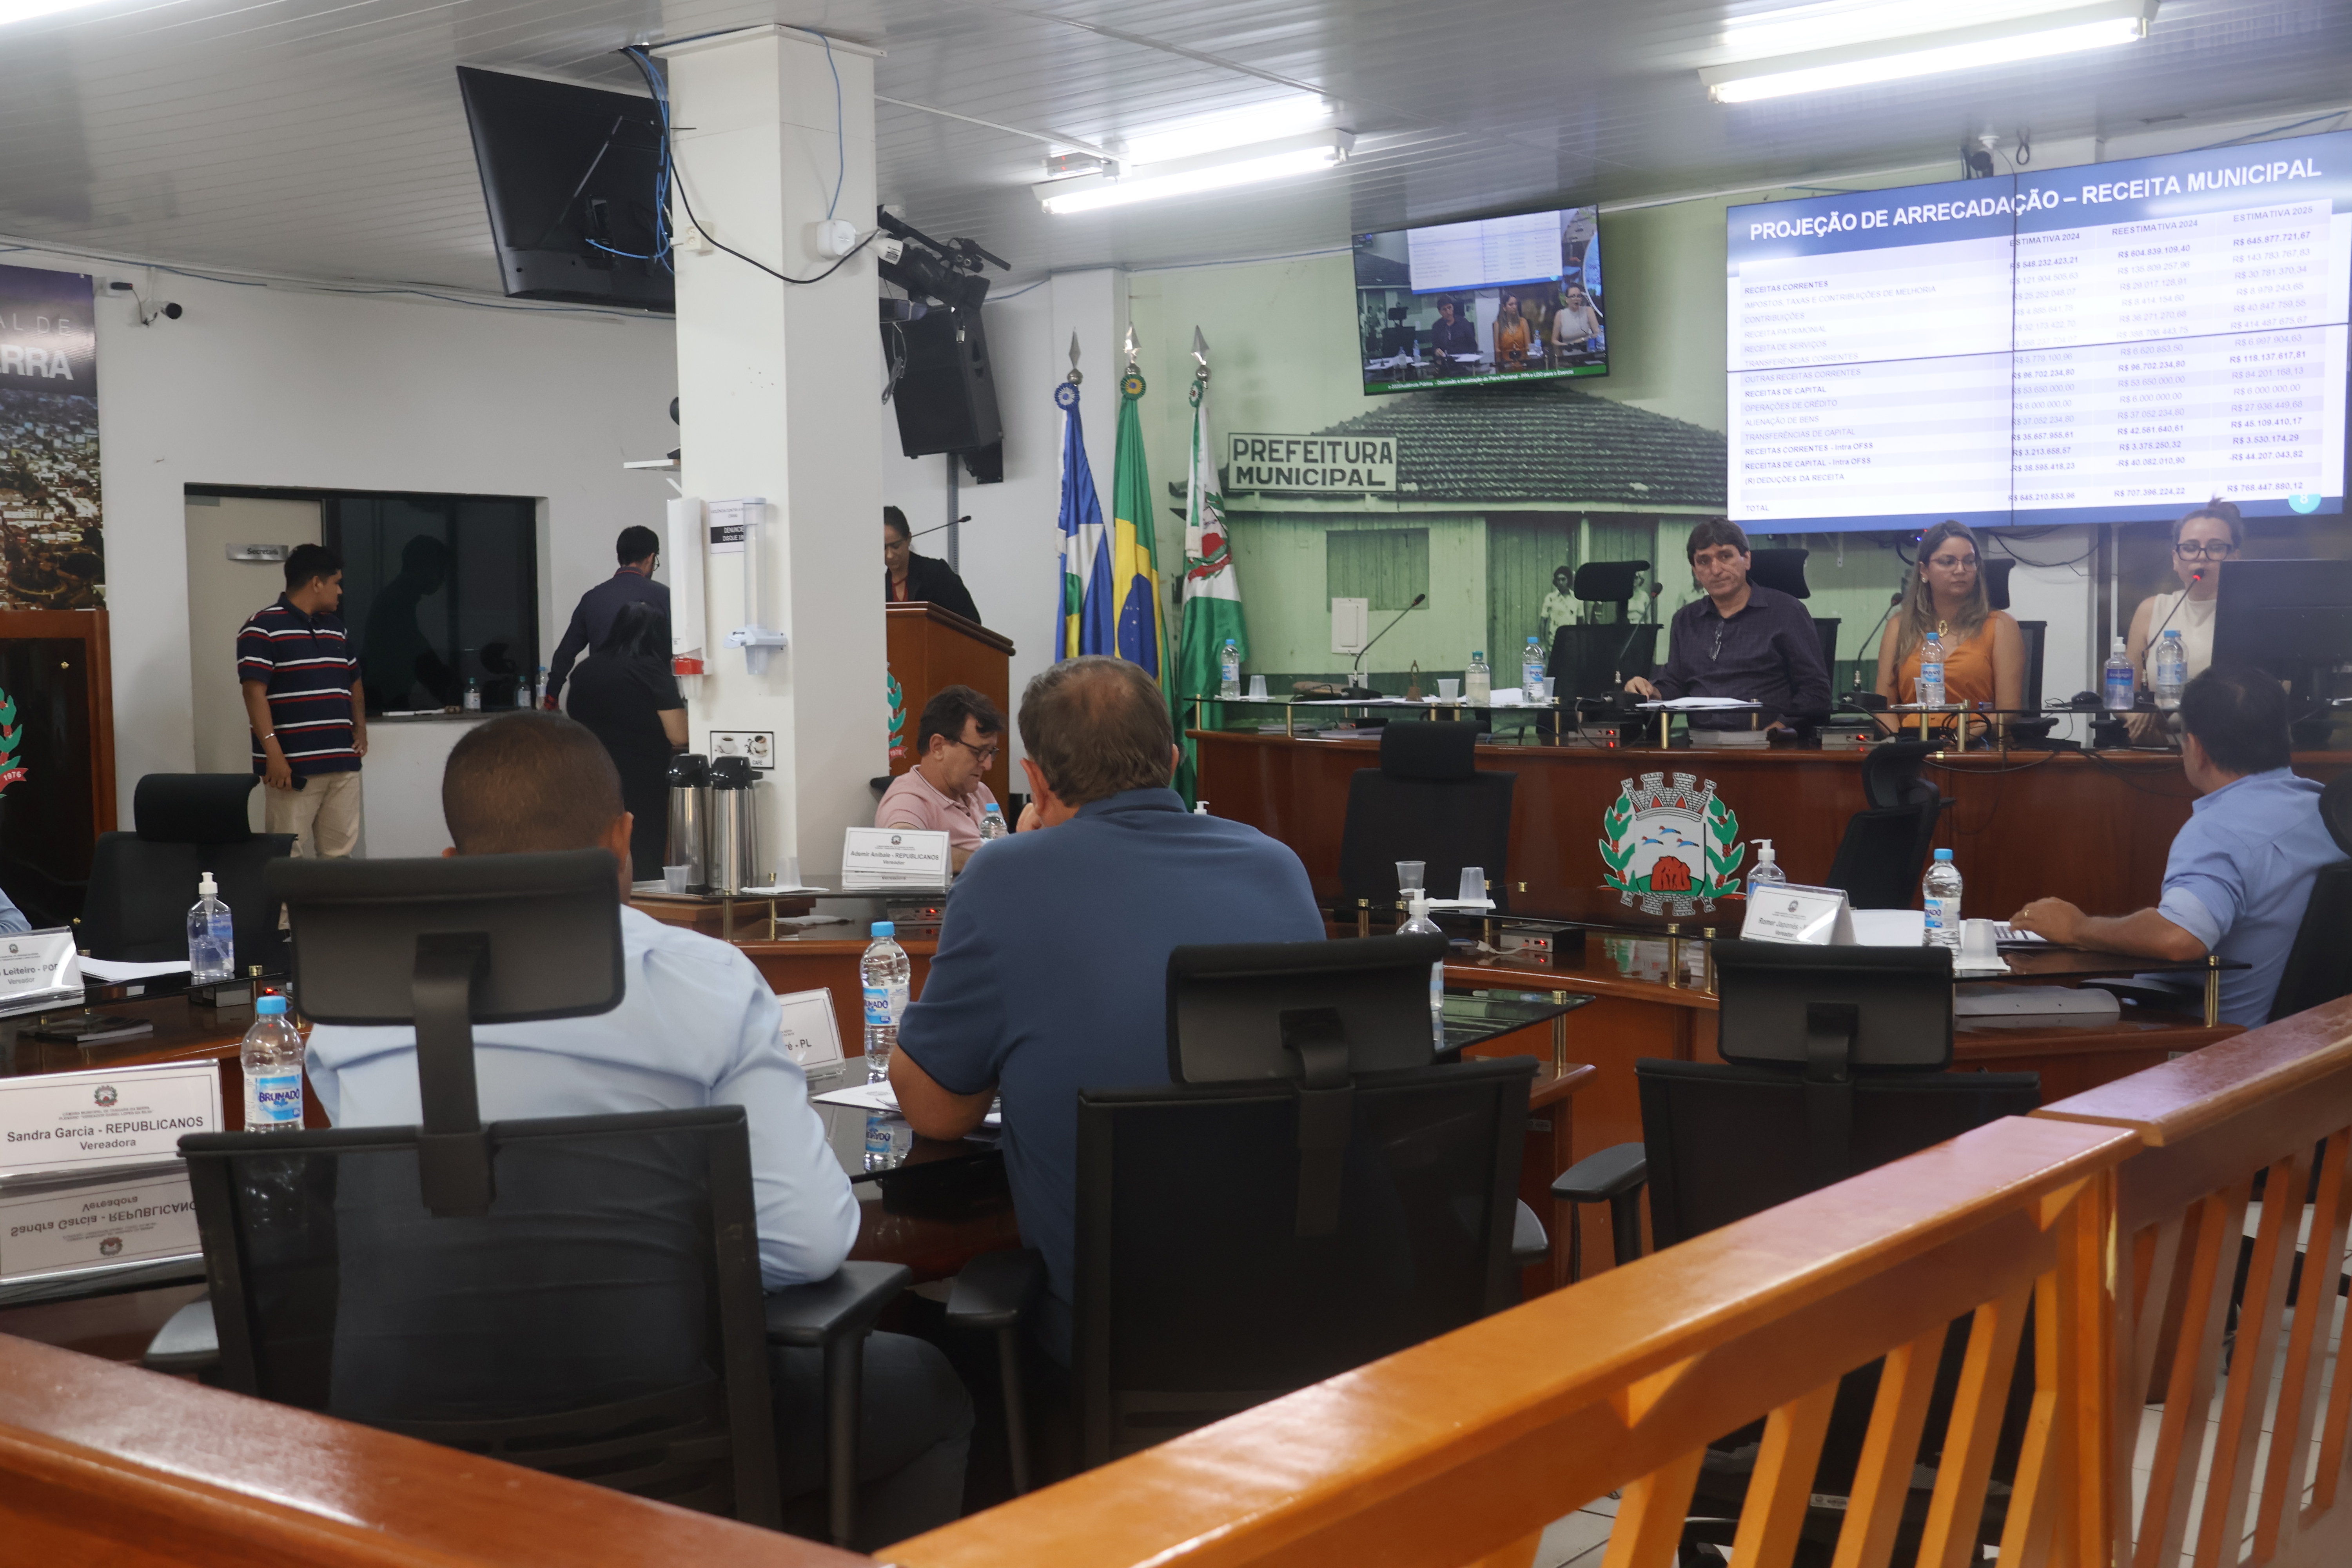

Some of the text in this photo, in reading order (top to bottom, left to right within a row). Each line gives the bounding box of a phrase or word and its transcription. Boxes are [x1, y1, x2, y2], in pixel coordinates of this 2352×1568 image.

[1751, 210, 1857, 243] PROJEÇÃO
[1862, 209, 1888, 229] DE
[1893, 189, 2059, 226] ARRECADAÇÃO
[2082, 175, 2180, 204] RECEITA
[2188, 157, 2321, 191] MUNICIPAL
[2234, 206, 2312, 222] ESTIMATIVA 2025
[2112, 220, 2198, 236] REESTIMATIVA 2024
[2010, 232, 2080, 247] ESTIMATIVA 2024
[2247, 231, 2310, 245] 645.877.721,67
[2131, 245, 2190, 257] 604.839.109,40
[1745, 281, 1828, 294] RECEITAS CORRENTES
[1787, 297, 1809, 305] TAXAS
[1819, 290, 1881, 302] CONTRIBUIÇÕES
[1896, 286, 1936, 296] MELHORIA
[1744, 312, 1805, 324] CONTRIBUIÇÕES
[37, 316, 70, 336] DE
[1745, 325, 1826, 338] RECEITA PATRIMONIAL
[1744, 344, 1775, 353] RECEITA
[1789, 340, 1827, 350] SERVIÇOS
[0, 344, 74, 380] RRA
[1745, 353, 1858, 367] TRANSFERÊNCIAS CORRENTES
[2244, 351, 2305, 362] 118.137.617,81
[2131, 360, 2185, 371] 96.702.234,80
[1745, 368, 1861, 383] OUTRAS RECEITAS CORRENTES
[2024, 369, 2074, 378] 96.702.234,80
[1745, 389, 1781, 397] RECEITAS
[1745, 403, 1789, 412] OPERAÇÕES
[1804, 399, 1837, 408] CRÉDITO
[1745, 417, 1785, 426] ALIENAÇÃO
[2245, 417, 2302, 428] 45.109.410,17
[1746, 431, 1810, 441] TRANSFERÊNCIAS
[1825, 428, 1855, 436] CAPITAL
[2130, 425, 2183, 434] 42.561.640,61
[2247, 434, 2299, 443] 3.530.174,29
[1234, 439, 1393, 464] PREFEITURA
[1783, 445, 1828, 453] CORRENTES
[2132, 441, 2181, 450] 3.375.250,32
[2245, 450, 2303, 460] 44.207.043,82
[2131, 457, 2185, 466] 40.082.010,90
[1236, 466, 1386, 486] MUNICIPAL
[1757, 475, 1797, 484] DEDUÇÕES
[2127, 488, 2185, 496] 707.396.224,22
[2240, 482, 2303, 491] 768.447.880,12
[3, 771, 22, 781] 1976
[3, 967, 35, 976] Leiteiro
[800, 1039, 812, 1049] PL
[260, 1088, 299, 1102] BRUNADO
[7, 1130, 51, 1142] Sandra
[55, 1126, 94, 1138] Garcia
[106, 1116, 203, 1134] REPUBLICANOS
[80, 1139, 136, 1151] Vereadora
